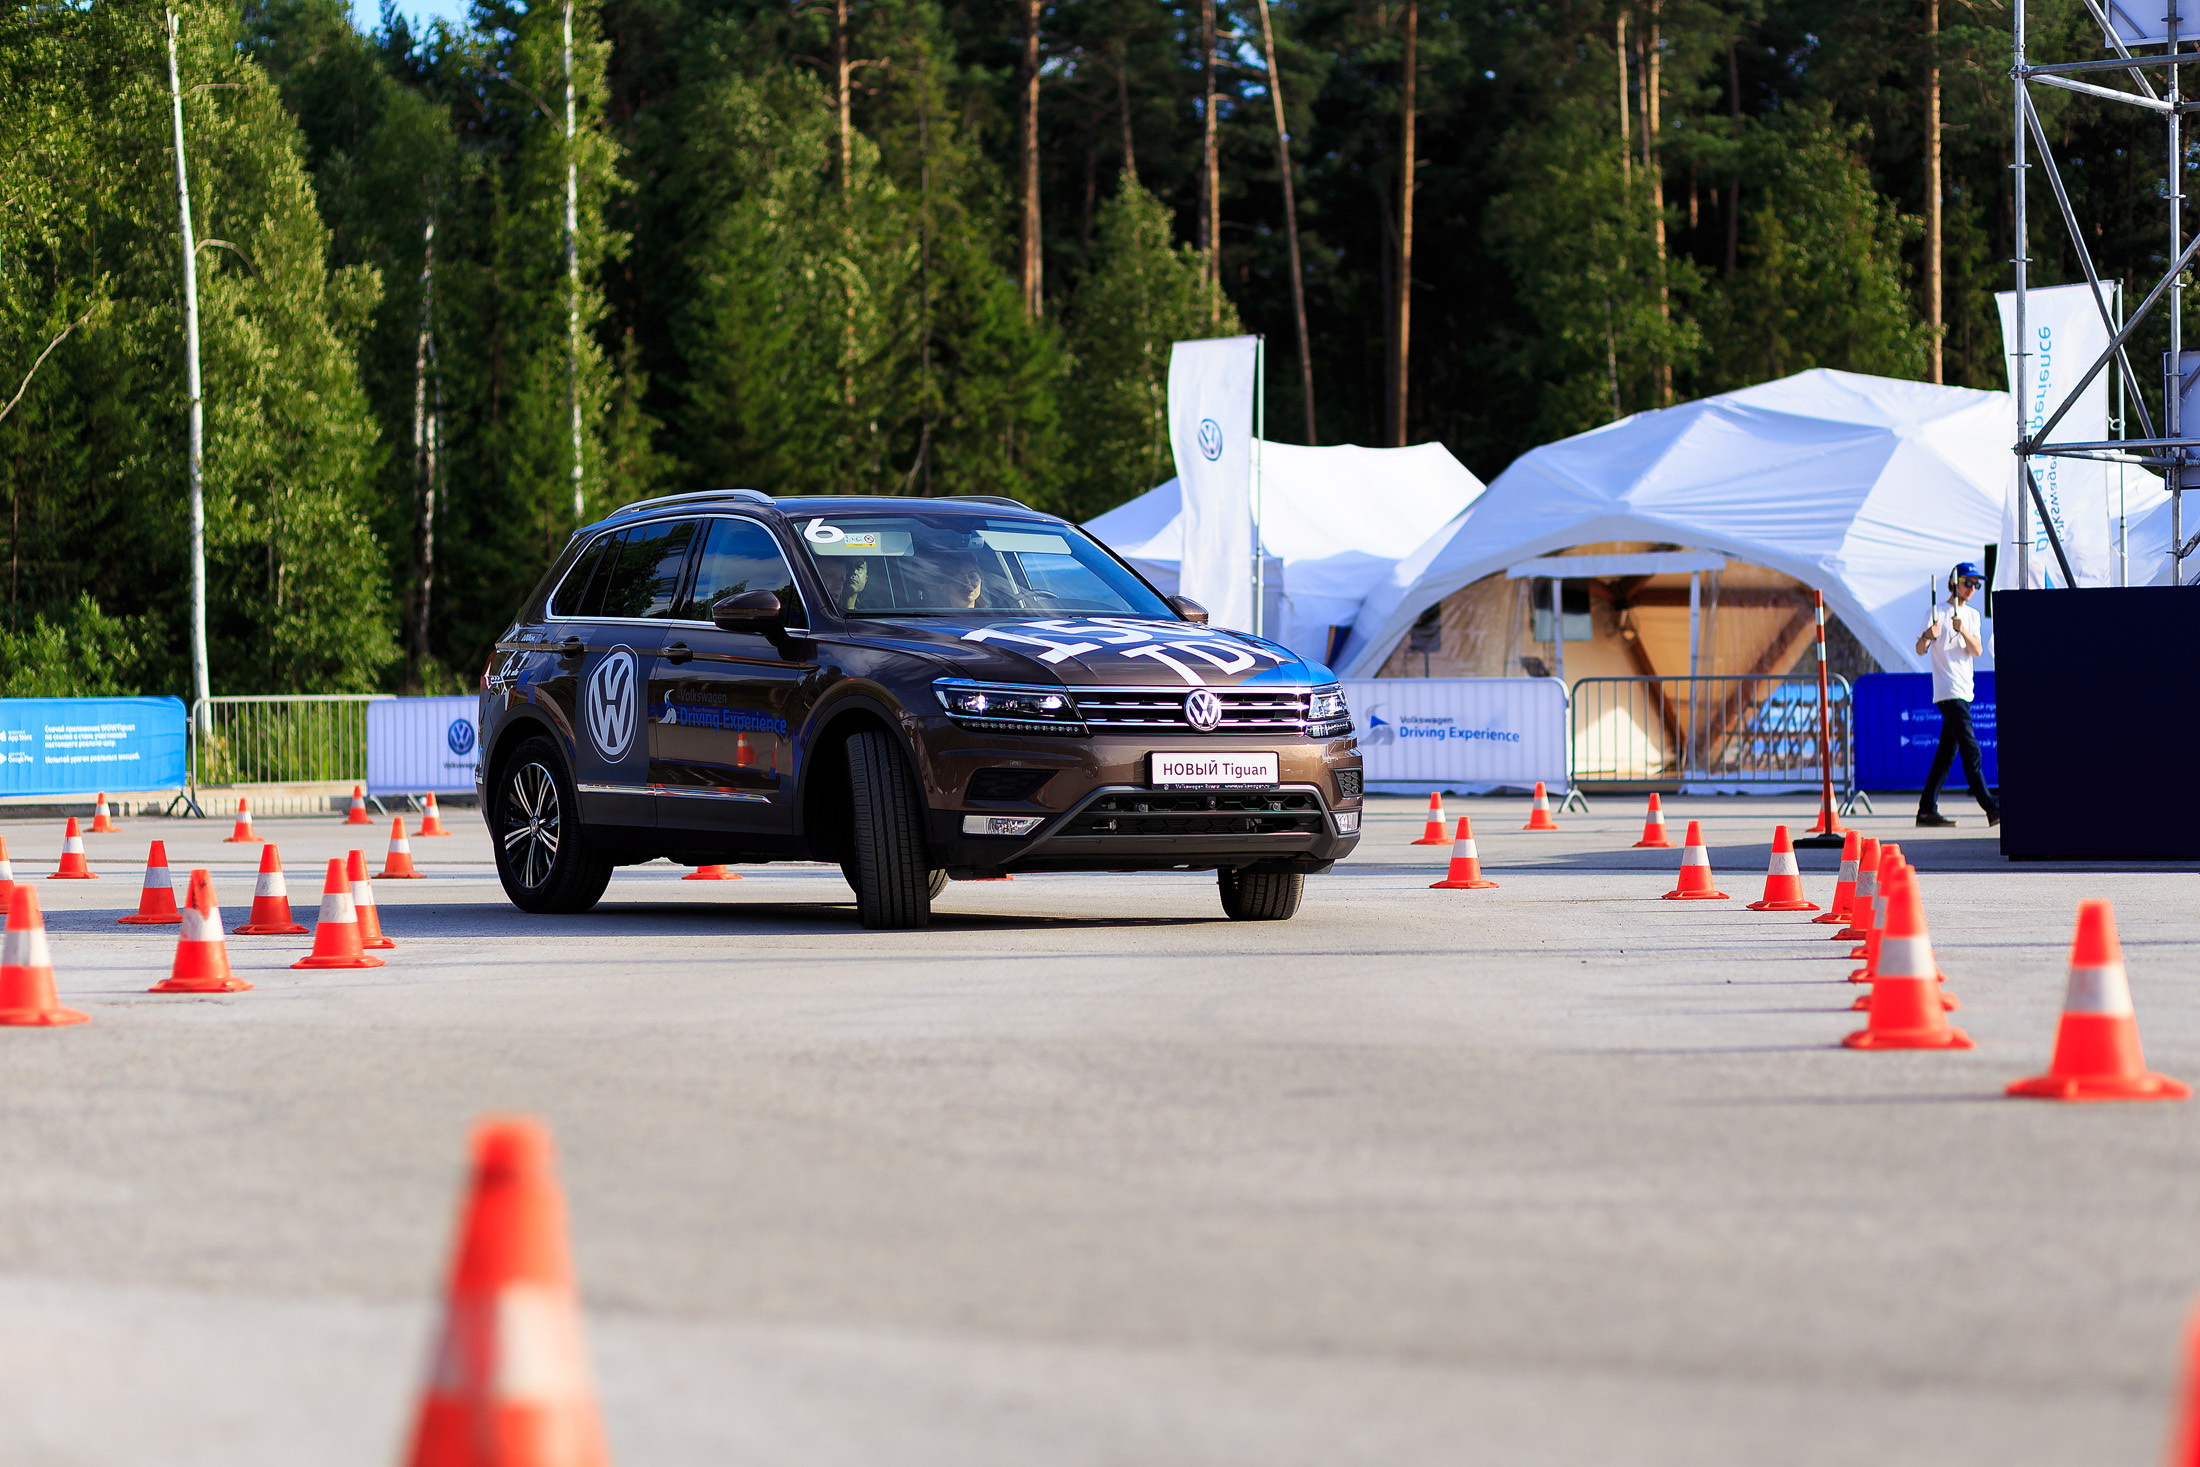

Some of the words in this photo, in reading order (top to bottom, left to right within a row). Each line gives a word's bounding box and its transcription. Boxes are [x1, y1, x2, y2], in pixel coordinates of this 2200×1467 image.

[803, 518, 845, 543] 6
[680, 689, 728, 705] Volkswagen
[680, 707, 720, 733] Driving
[723, 709, 787, 734] Experience
[1400, 716, 1453, 725] Volkswagen
[1400, 726, 1445, 741] Driving
[1449, 727, 1519, 742] Experience
[1163, 760, 1218, 776] НОВЫЙ
[1222, 762, 1267, 778] Tiguan
